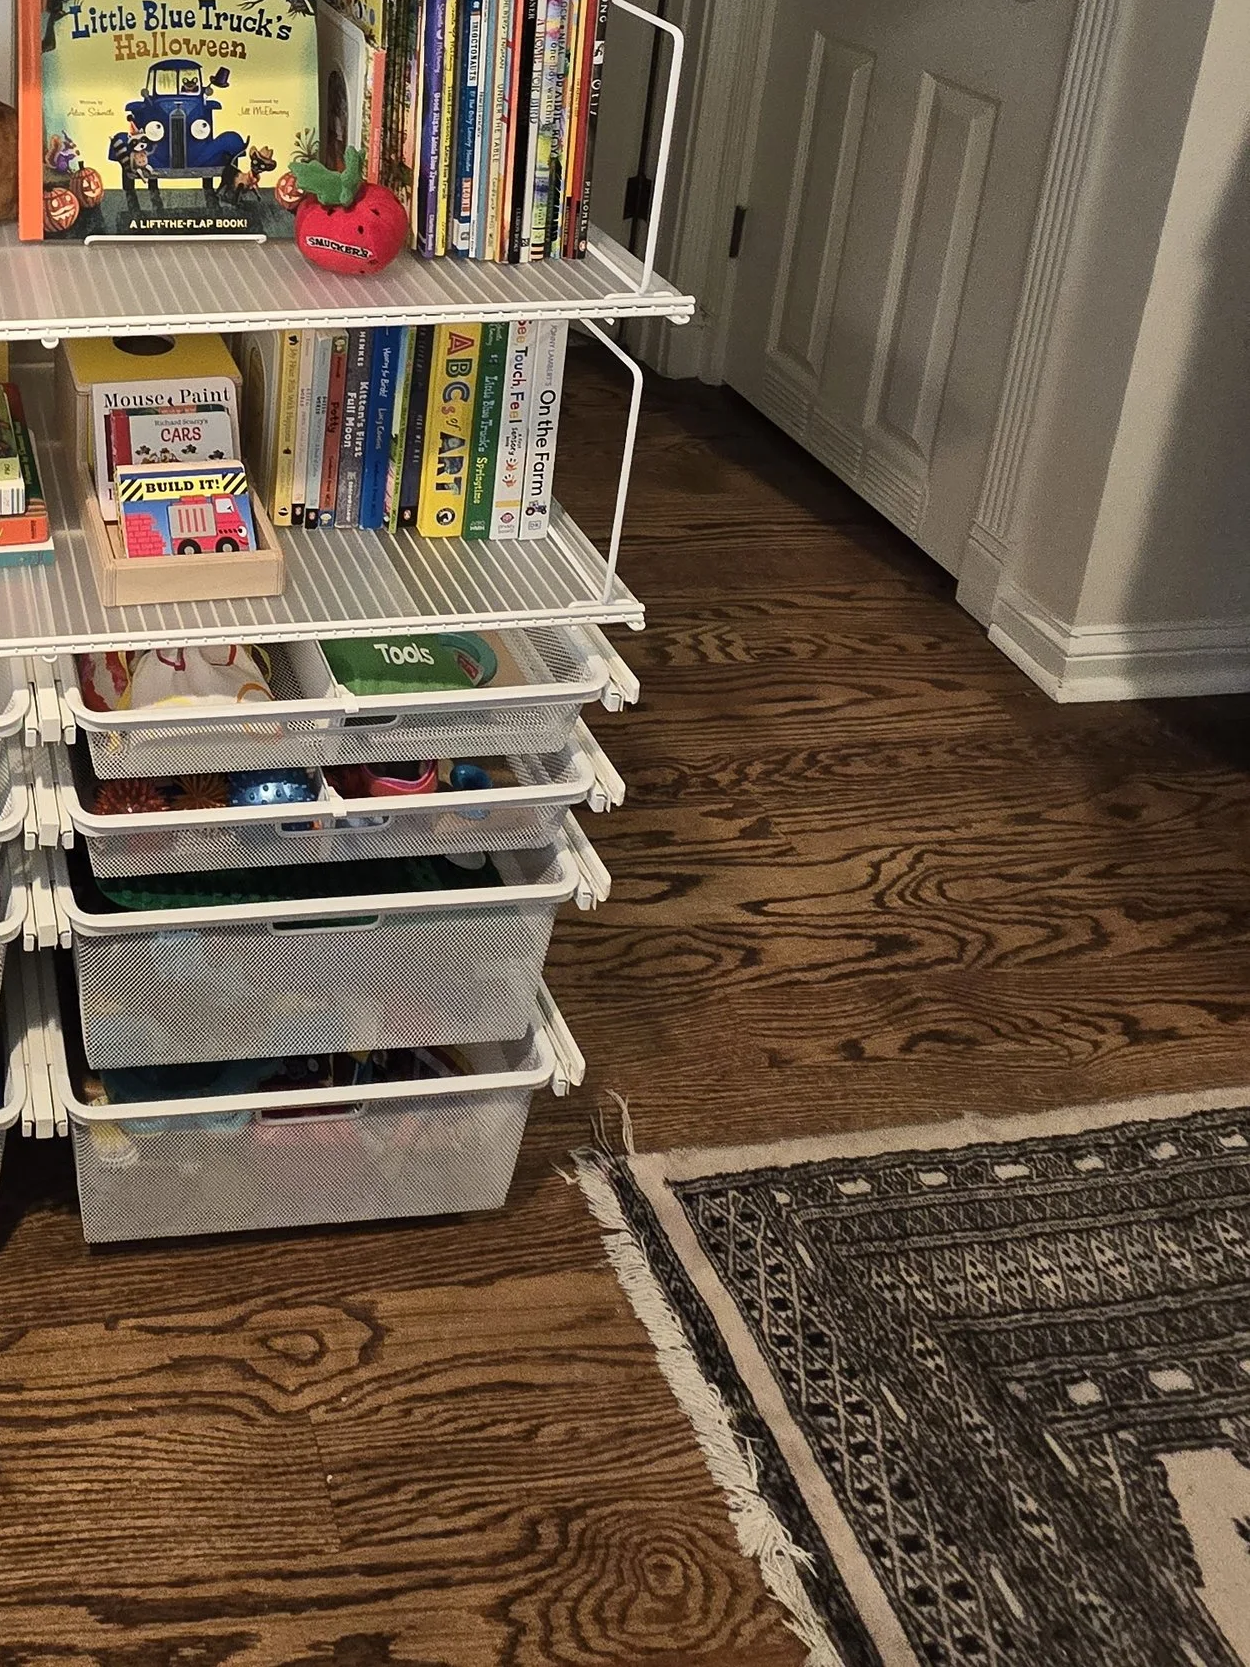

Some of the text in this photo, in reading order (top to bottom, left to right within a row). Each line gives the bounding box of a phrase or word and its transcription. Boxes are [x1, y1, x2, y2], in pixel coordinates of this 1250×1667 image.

[70, 0, 292, 41] Little Blue Truck's
[113, 31, 247, 62] Halloween
[469, 33, 479, 81] OCTONAUTS
[129, 218, 247, 229] A LIFT-THE-FLAP BOOK!
[581, 181, 591, 231] PHILOMEL
[357, 331, 366, 366] HENKES
[509, 346, 528, 389] Touch,
[104, 387, 231, 409] Mouse Paint
[328, 401, 341, 433] Potty
[435, 331, 475, 496] ABCs of ART
[508, 391, 524, 424] Feel
[160, 427, 202, 442] CARS
[344, 392, 357, 447] Full Moon
[354, 381, 369, 457] Kitten's First
[473, 375, 498, 504] Little Blue Truck's Springtime
[530, 389, 557, 496] On the Farm
[145, 478, 220, 493] BUILD IT!
[374, 642, 435, 665] Tools
